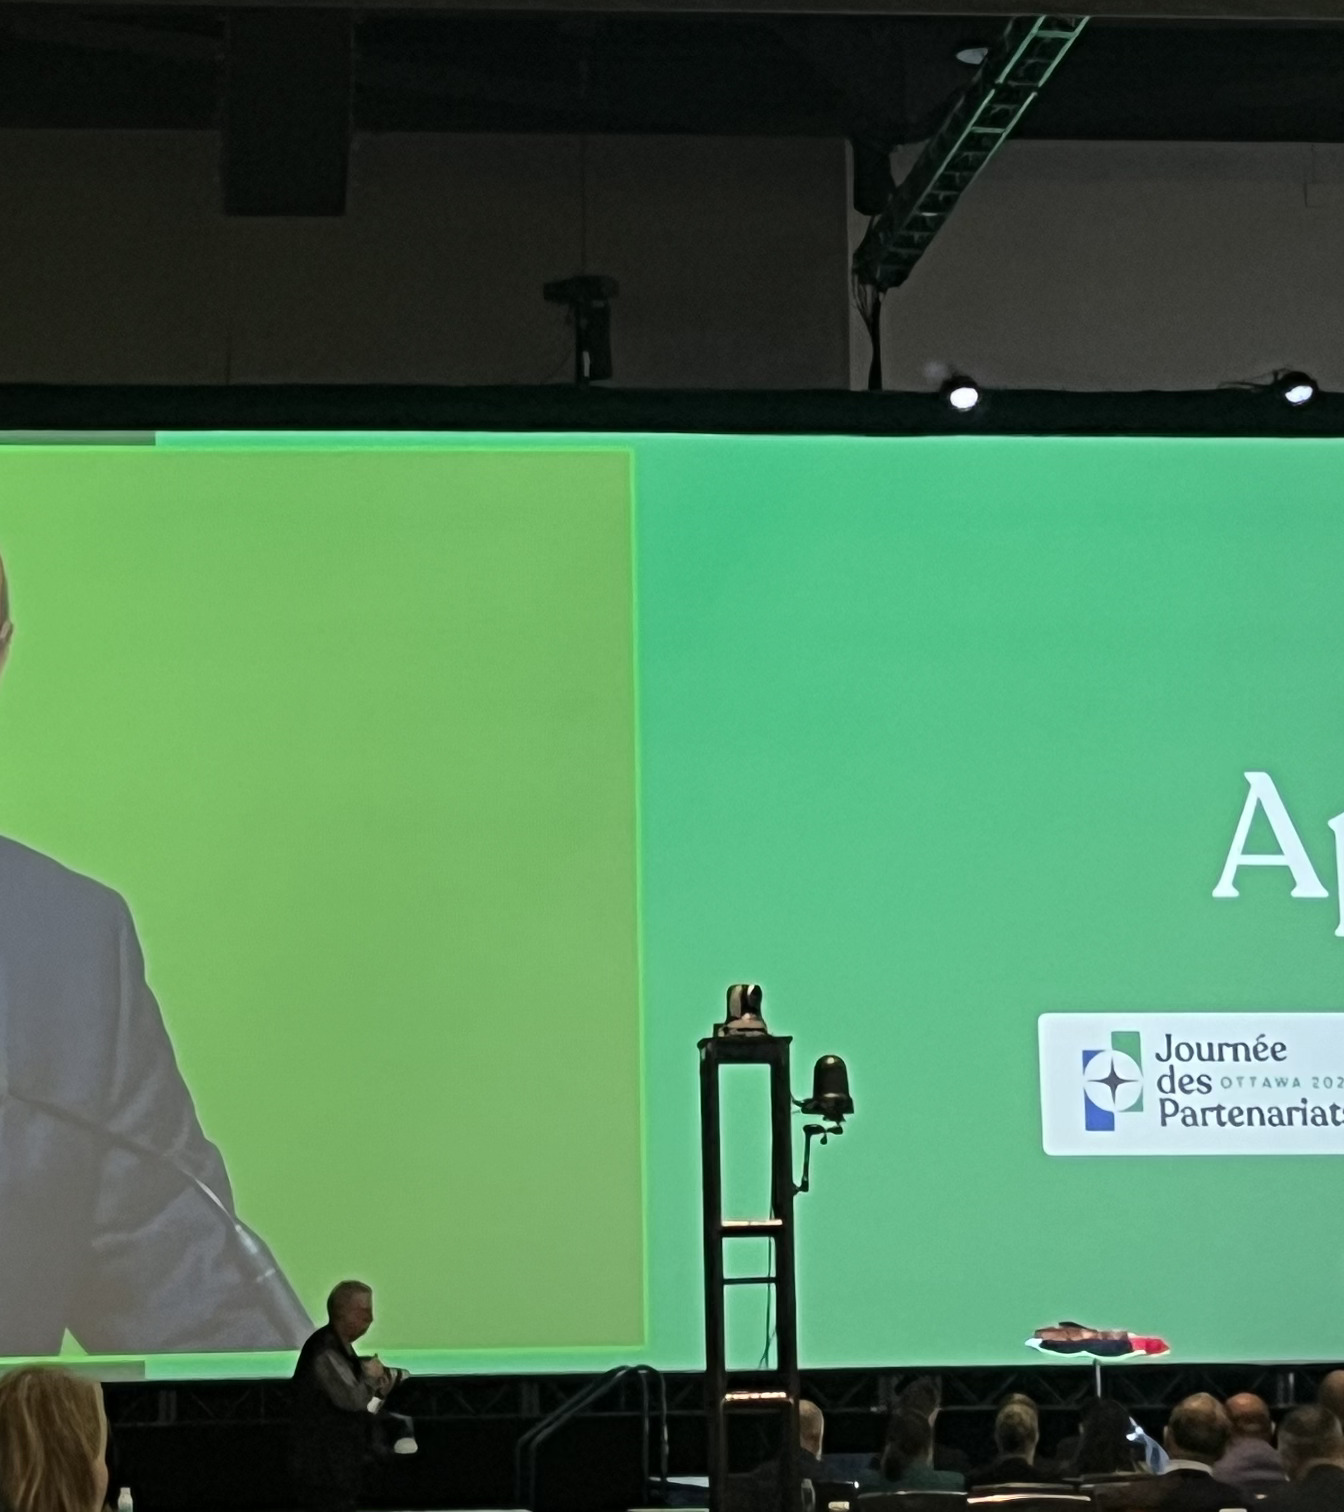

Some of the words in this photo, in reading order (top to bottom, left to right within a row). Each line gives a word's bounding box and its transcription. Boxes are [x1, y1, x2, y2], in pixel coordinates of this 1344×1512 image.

[1154, 1033, 1289, 1063] Journée
[1156, 1064, 1215, 1095] des
[1219, 1076, 1303, 1090] OTTAWA
